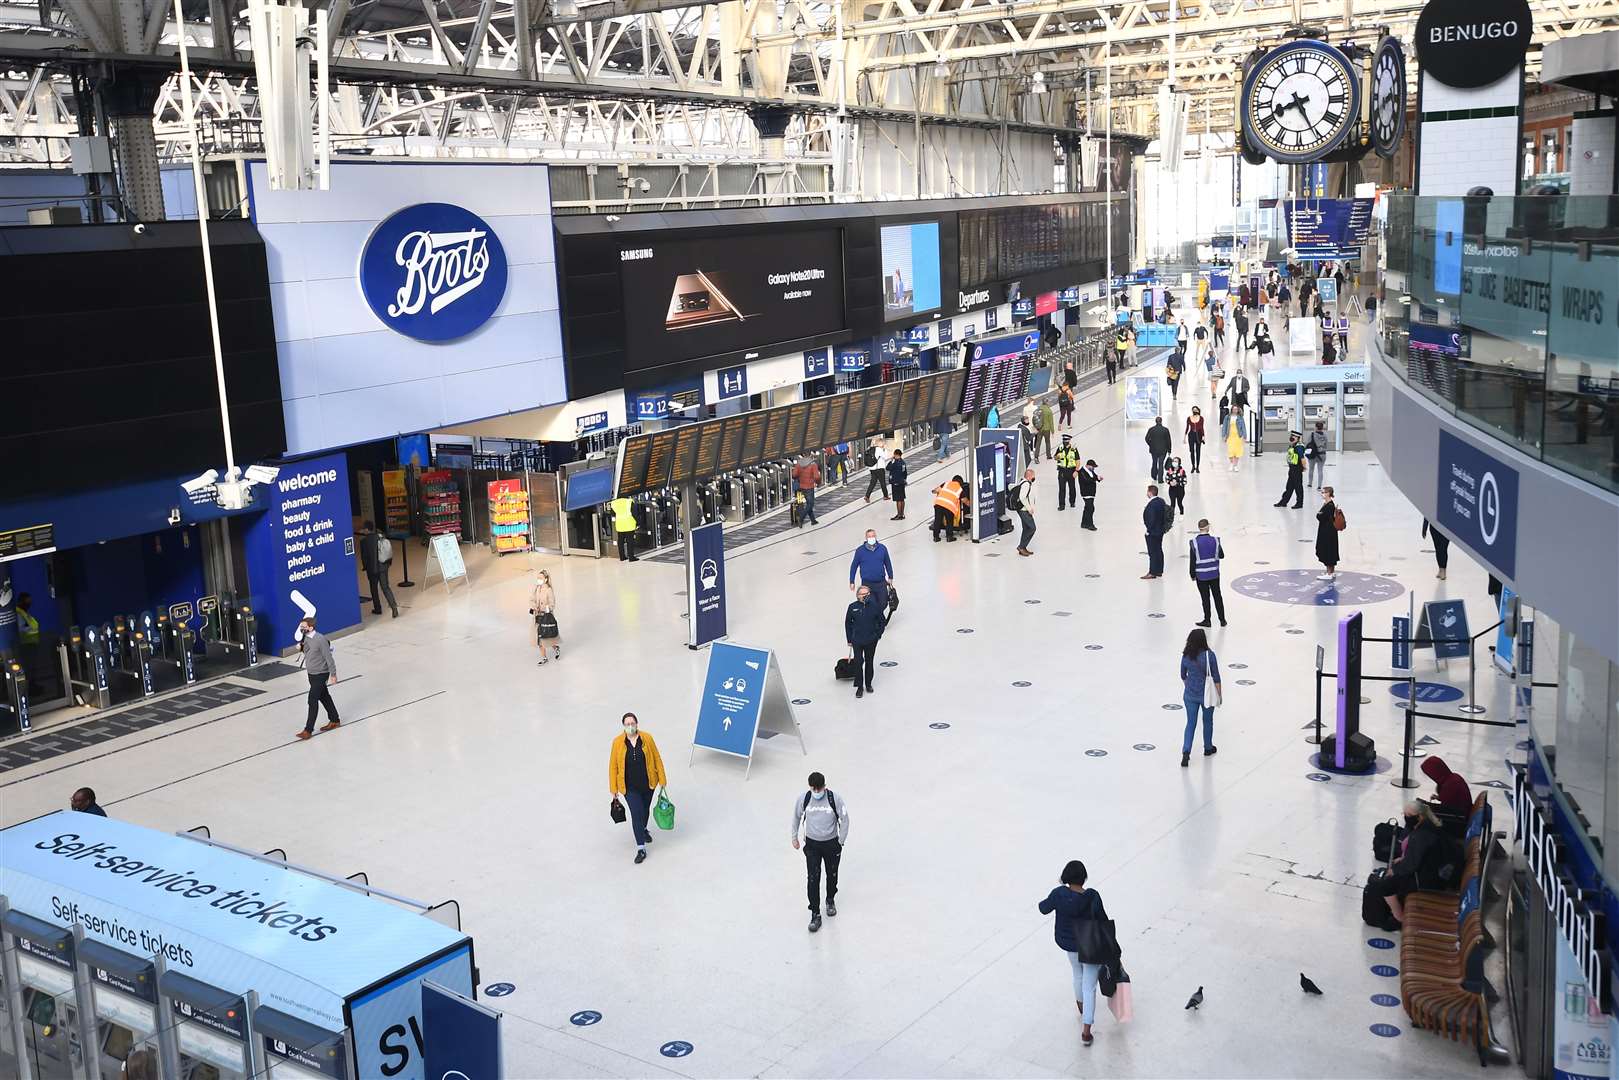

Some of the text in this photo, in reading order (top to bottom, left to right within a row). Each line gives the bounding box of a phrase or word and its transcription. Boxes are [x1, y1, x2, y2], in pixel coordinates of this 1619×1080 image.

[1430, 21, 1518, 43] BENUGO
[620, 248, 653, 261] SAMSUNG
[387, 228, 490, 318] Boots
[768, 273, 790, 286] Galaxy
[959, 289, 990, 310] Departures
[1064, 290, 1074, 298] 16
[1016, 303, 1027, 311] 15
[1562, 285, 1604, 325] WRAPS
[910, 330, 923, 340] 14
[843, 356, 856, 367] 13
[640, 401, 654, 414] 12
[656, 400, 667, 414] 12
[278, 469, 337, 492] welcome
[281, 494, 321, 512] pharmacy
[283, 511, 310, 525] beauty
[284, 518, 333, 539] food & drink
[286, 532, 334, 554] baby & child
[287, 554, 311, 569] photo
[289, 563, 325, 582] electrical
[34, 832, 338, 942] Self-service tickets
[52, 895, 194, 968] Self-service tickets
